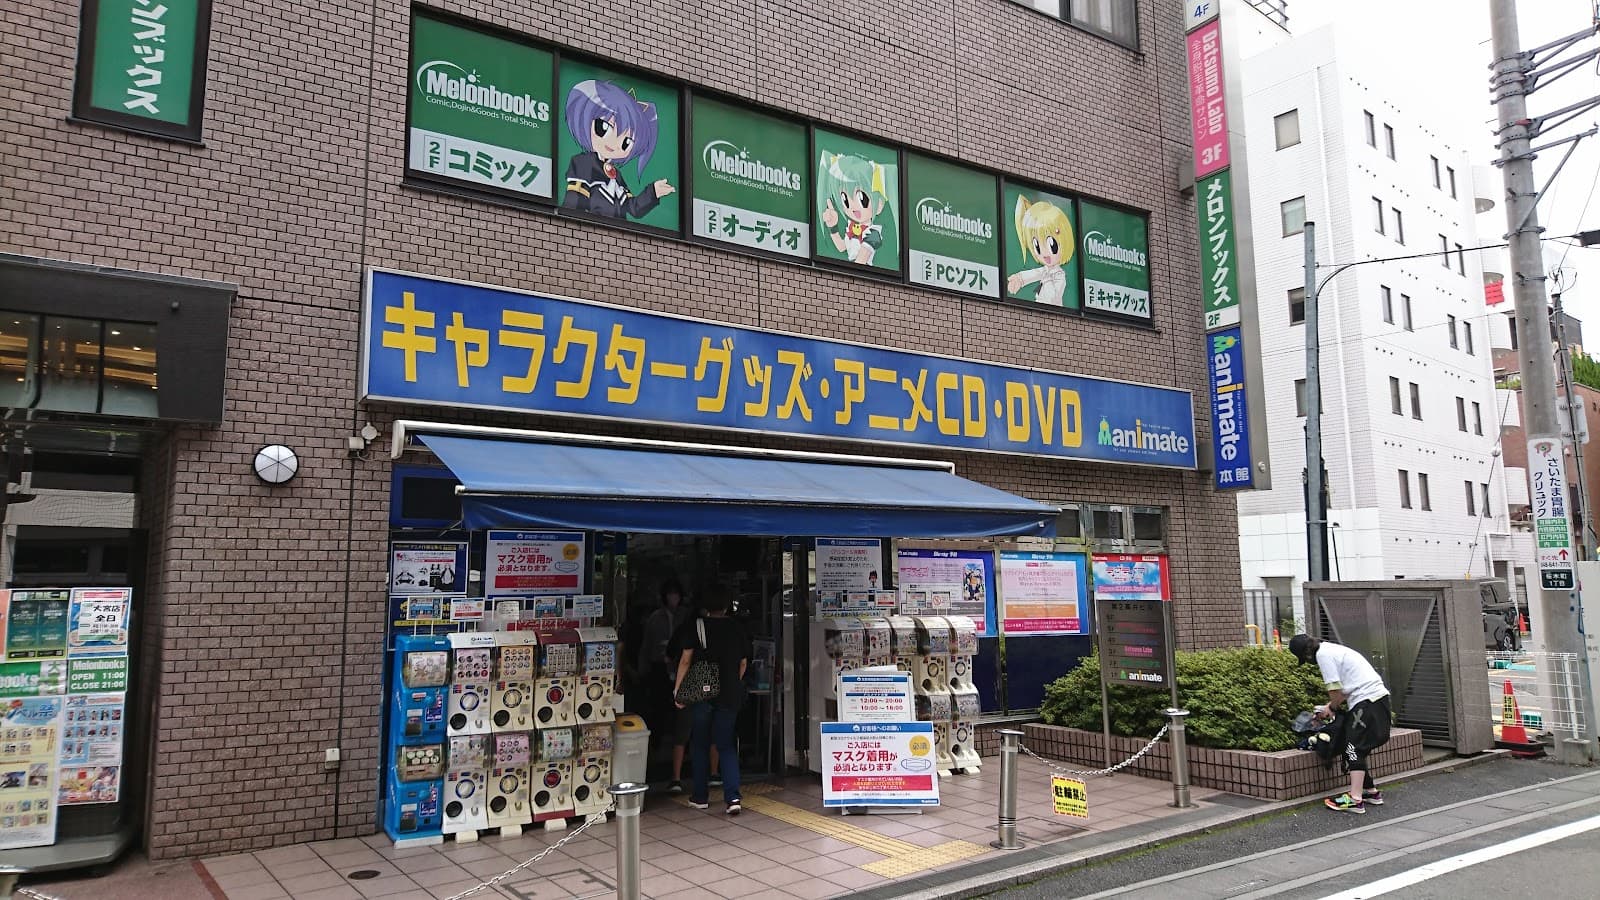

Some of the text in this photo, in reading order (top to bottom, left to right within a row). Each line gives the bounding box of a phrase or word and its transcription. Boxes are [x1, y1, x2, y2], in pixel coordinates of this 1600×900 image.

[1194, 3, 1209, 17] 4F
[427, 69, 549, 122] Melonbooks
[1203, 30, 1224, 135] Datsumo Labo
[426, 95, 500, 120] Comic,Dojin&Goods
[501, 112, 519, 124] Total
[429, 141, 441, 169] 2F
[449, 147, 541, 188] コミック
[1202, 143, 1222, 165] 3F
[711, 149, 800, 190] Melonbooks
[766, 185, 778, 193] Total
[708, 210, 717, 234] 2F
[723, 214, 801, 250] オーディオ
[921, 205, 992, 239] Melonbooks
[1088, 237, 1146, 267] Melonbooks
[1207, 178, 1231, 306] メロンブックス
[925, 260, 932, 280] 2F
[937, 263, 988, 291] PCソフト
[1089, 286, 1095, 304] 2F
[1097, 288, 1147, 314] キャラグッズ
[1208, 313, 1220, 326] 2F
[382, 292, 1083, 448] キャラクターグッズ・アニメCD・DVD
[1215, 353, 1243, 461] animate
[1112, 419, 1189, 453] animate
[1219, 467, 1250, 483] 本館
[1547, 457, 1565, 518] さいたま胃腸
[1534, 471, 1546, 518] クリニック
[497, 554, 553, 564] マスク着用が
[72, 660, 125, 670] Melonbooks
[1129, 670, 1163, 682] animate
[832, 751, 898, 762] マスク着用が
[912, 742, 928, 750] 必須
[833, 763, 897, 772] 必須となります。
